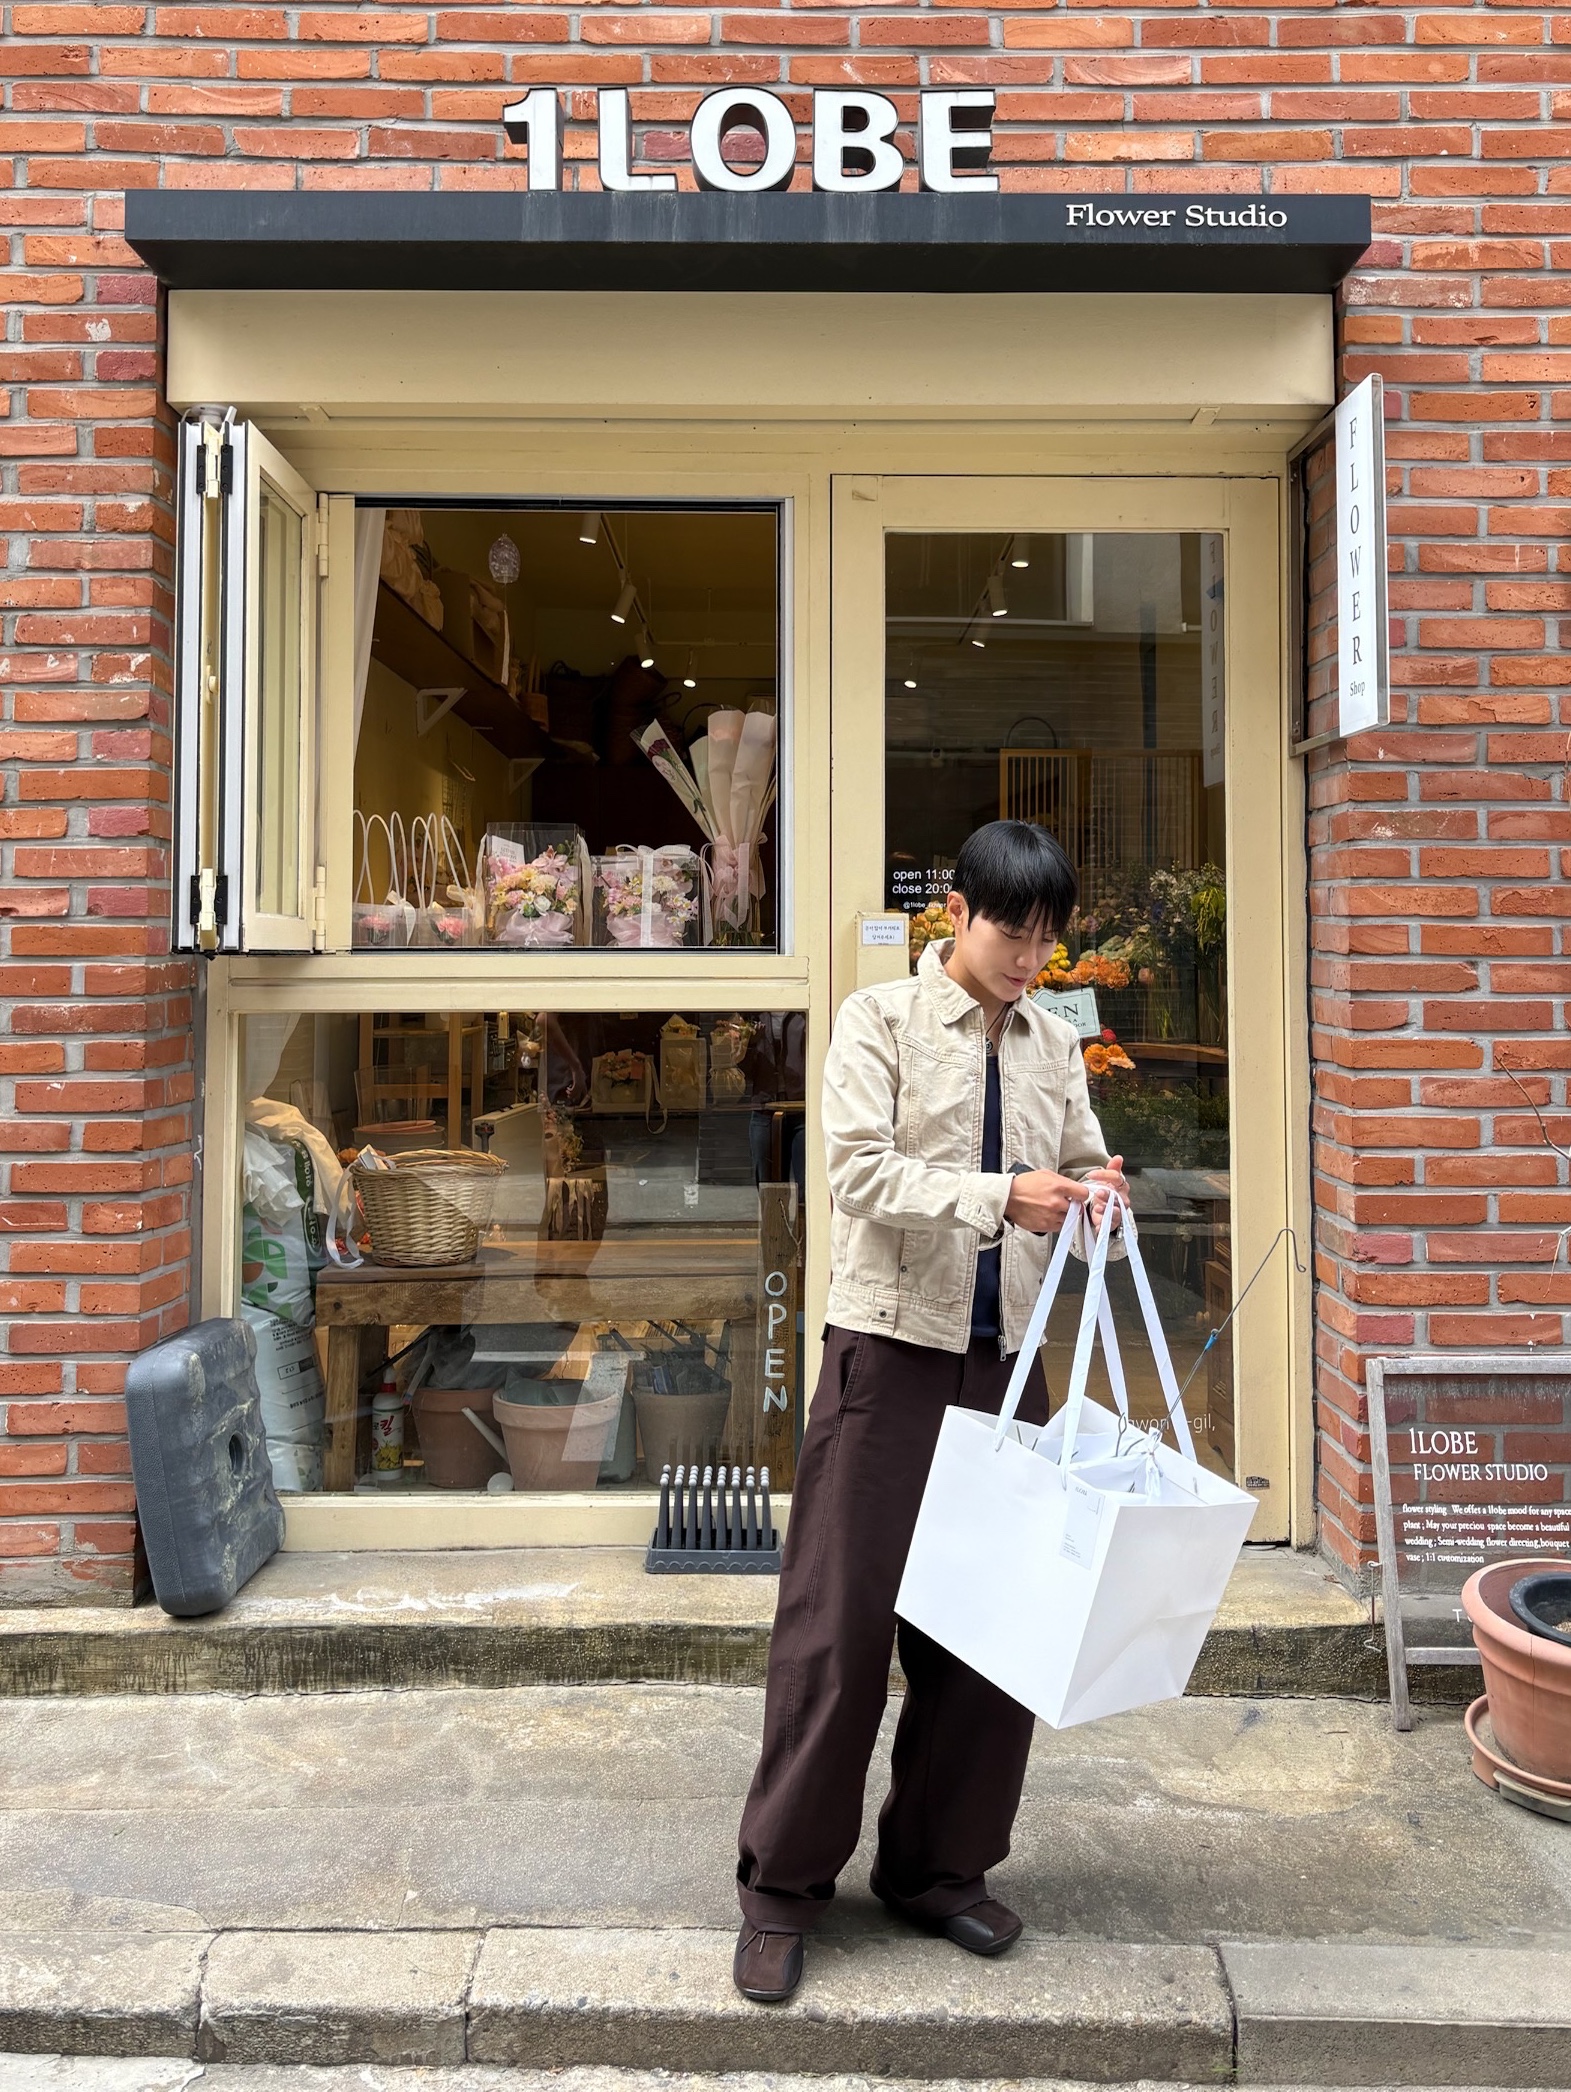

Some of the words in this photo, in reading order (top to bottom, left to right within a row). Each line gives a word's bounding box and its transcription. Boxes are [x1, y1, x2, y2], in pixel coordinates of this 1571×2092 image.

[502, 86, 1000, 192] 1LOBE
[1065, 203, 1176, 227] Flower
[1185, 204, 1288, 227] Studio
[1349, 417, 1363, 665] FLOWER
[1349, 680, 1366, 697] Shop
[893, 870, 922, 882] open
[892, 883, 922, 894] close
[925, 883, 952, 894] 20:0
[763, 1271, 788, 1413] OPEN
[1409, 1427, 1478, 1455] 1LOBE
[1414, 1464, 1482, 1481] FLOWER
[1485, 1464, 1548, 1481] STUDIO
[1451, 1505, 1463, 1514] We
[1507, 1505, 1528, 1515] mood
[1529, 1505, 1539, 1515] for
[1540, 1508, 1553, 1518] any
[1426, 1519, 1440, 1532] May
[1441, 1523, 1458, 1532] your
[1487, 1523, 1507, 1533] space
[1507, 1521, 1534, 1531] become
